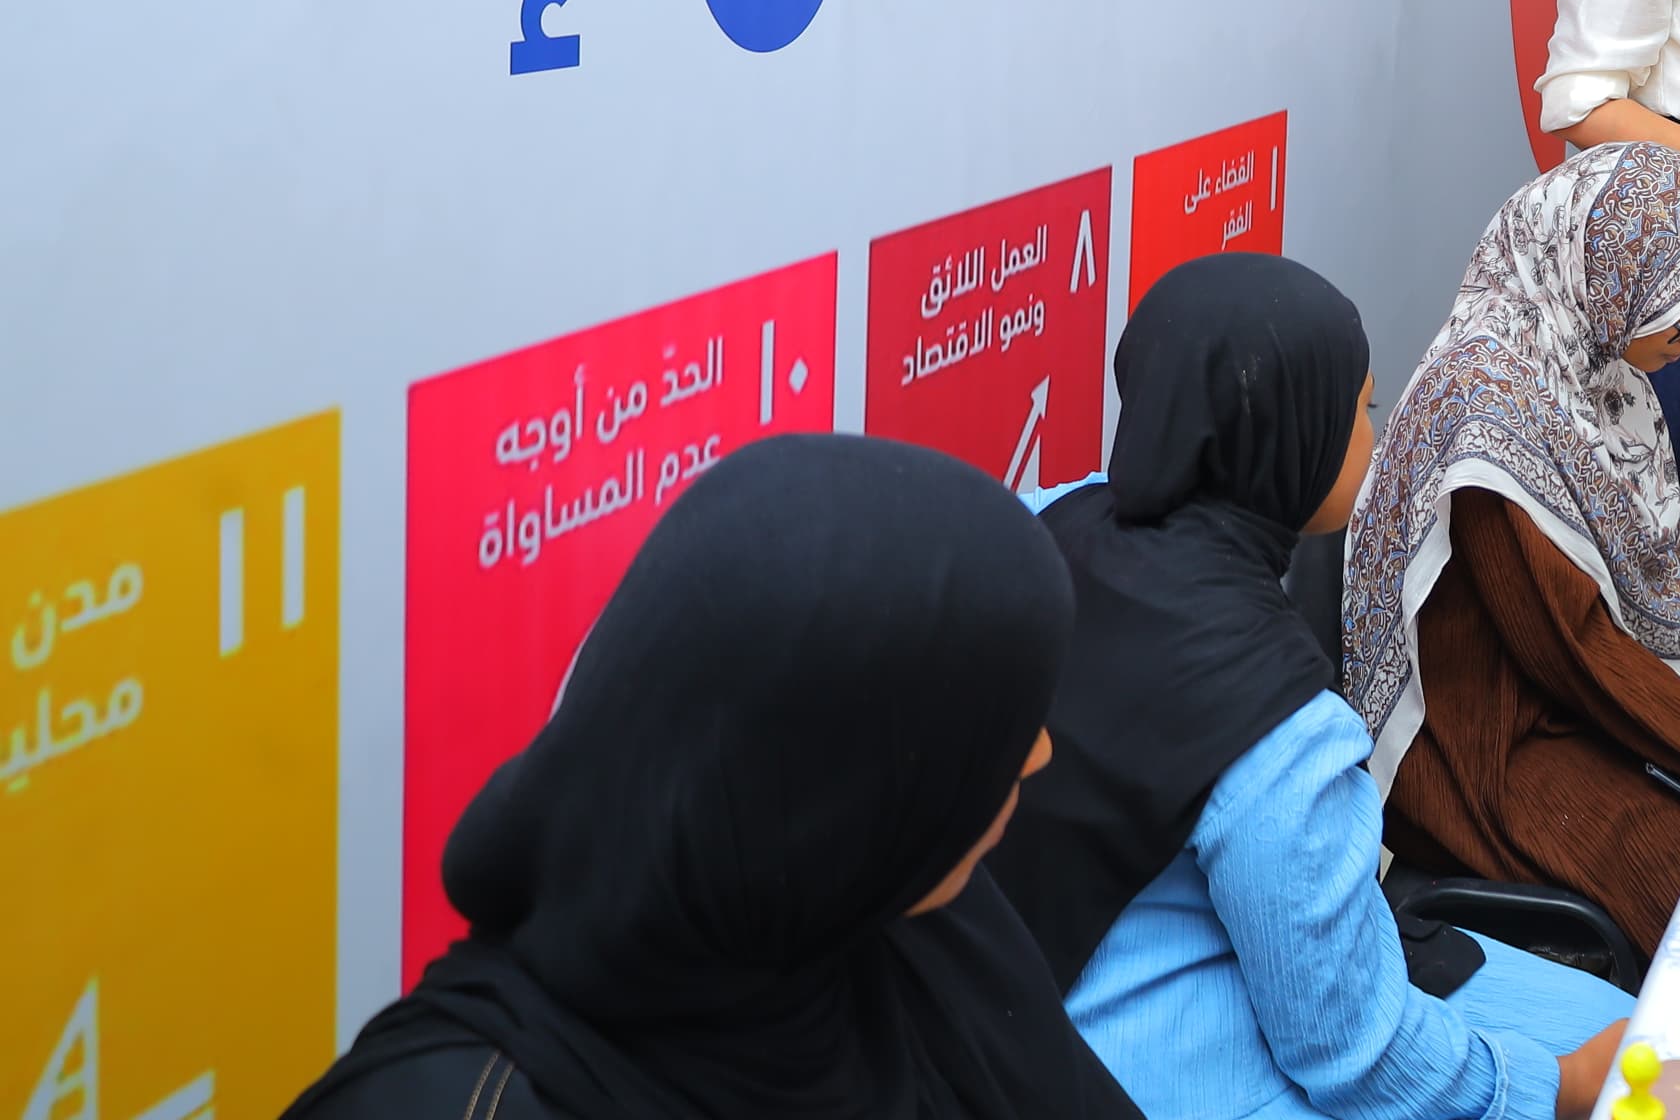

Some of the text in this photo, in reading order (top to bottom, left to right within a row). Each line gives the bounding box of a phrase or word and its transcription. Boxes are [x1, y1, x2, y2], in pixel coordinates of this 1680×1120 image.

[1184, 150, 1255, 215] القضاء على
[1222, 200, 1252, 251] الفقر
[921, 224, 1047, 318] العمل اللائق
[901, 294, 1045, 386] ونمو الاقتصاد
[495, 363, 585, 472] أوجه
[596, 381, 648, 443] من
[478, 434, 721, 568] عدم المساواة
[11, 561, 144, 671] مدن
[0, 677, 144, 795] محلي
